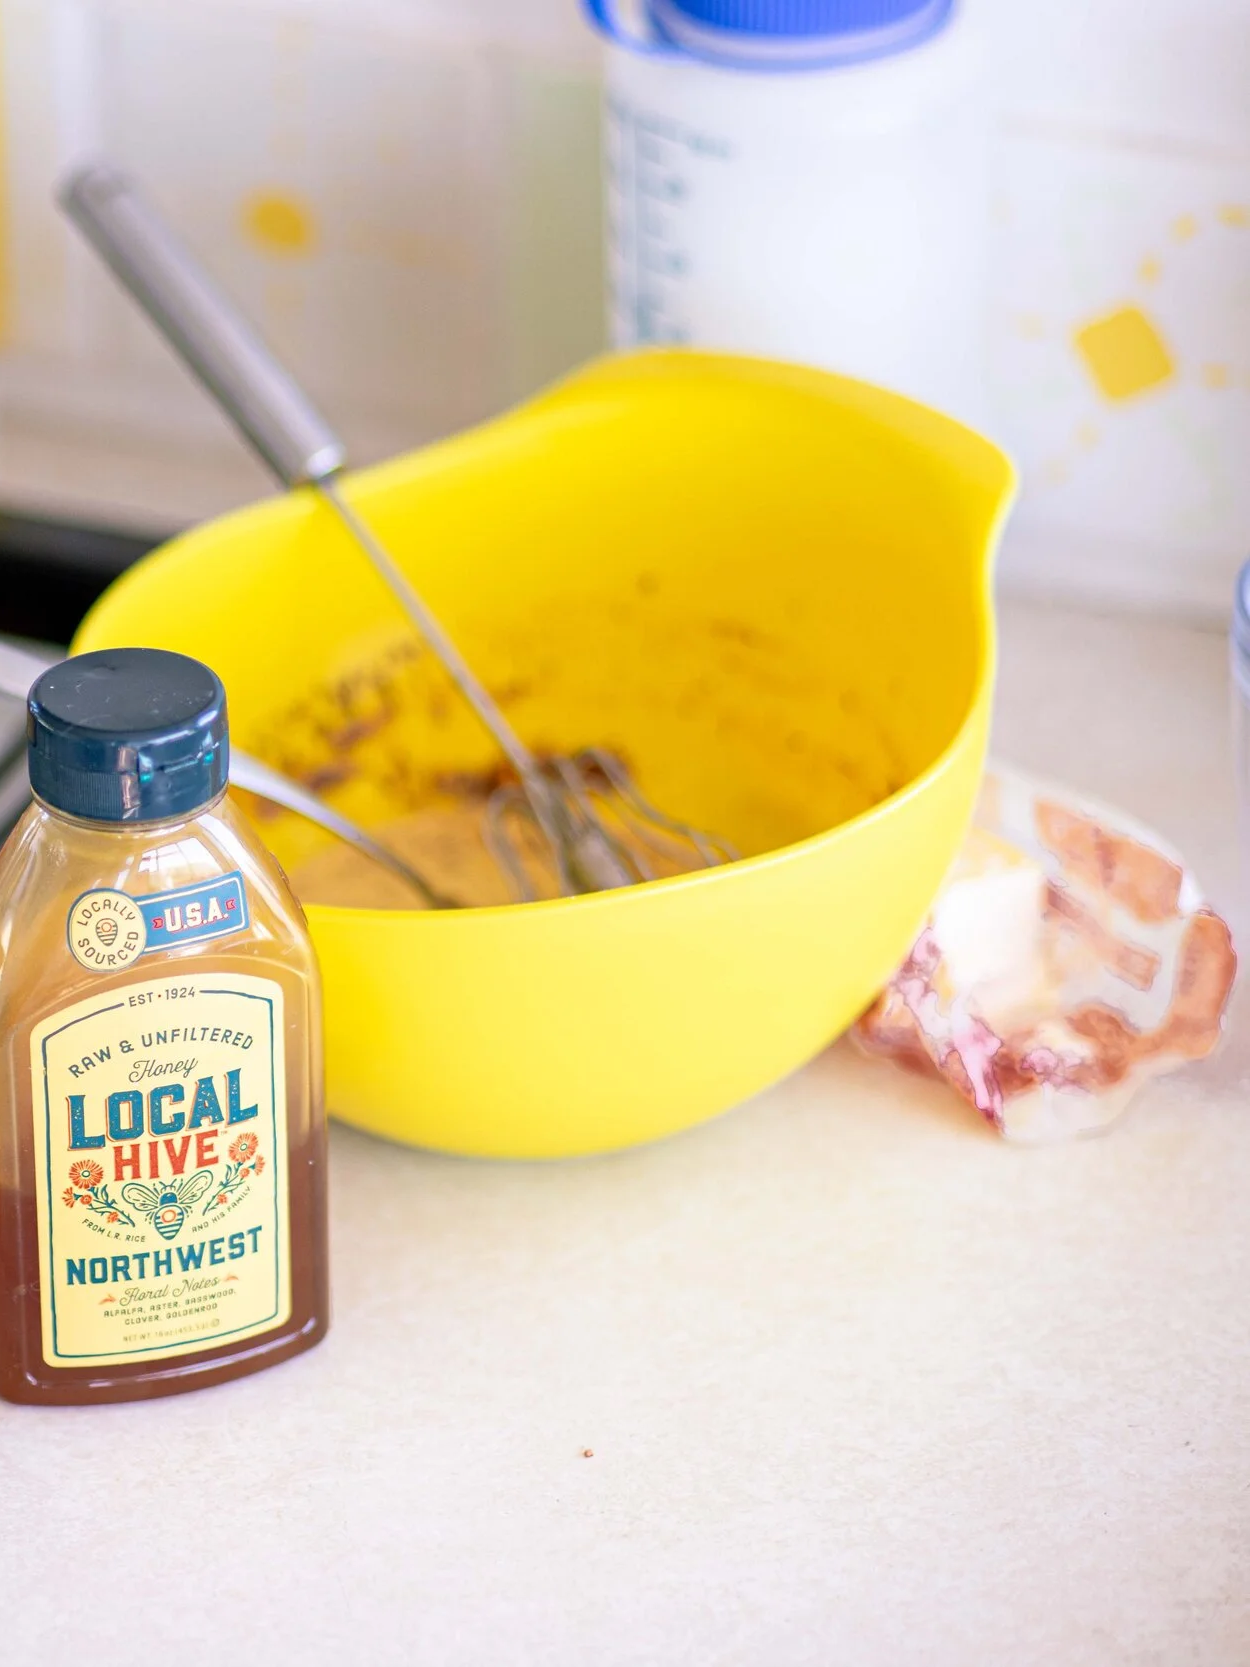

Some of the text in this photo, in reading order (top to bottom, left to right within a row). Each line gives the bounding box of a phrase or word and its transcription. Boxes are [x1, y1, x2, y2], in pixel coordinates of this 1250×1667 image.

[77, 898, 136, 926] LOCALLY
[163, 897, 229, 933] U.S.A.
[77, 931, 139, 966] SOURCED
[128, 987, 196, 1007] EST 1924
[68, 1027, 254, 1078] RAW & UNFILTERED
[128, 1057, 199, 1083] Honey
[66, 1068, 259, 1151] LOCAL
[113, 1129, 220, 1182] HIVE
[192, 1185, 252, 1233] AND HIS FAMILY
[82, 1218, 105, 1235] FROM
[125, 1235, 146, 1243] RICE
[66, 1225, 263, 1286] NORTHWEST
[119, 1276, 221, 1307] Floral Notes
[166, 1302, 218, 1320] GOLDENROD
